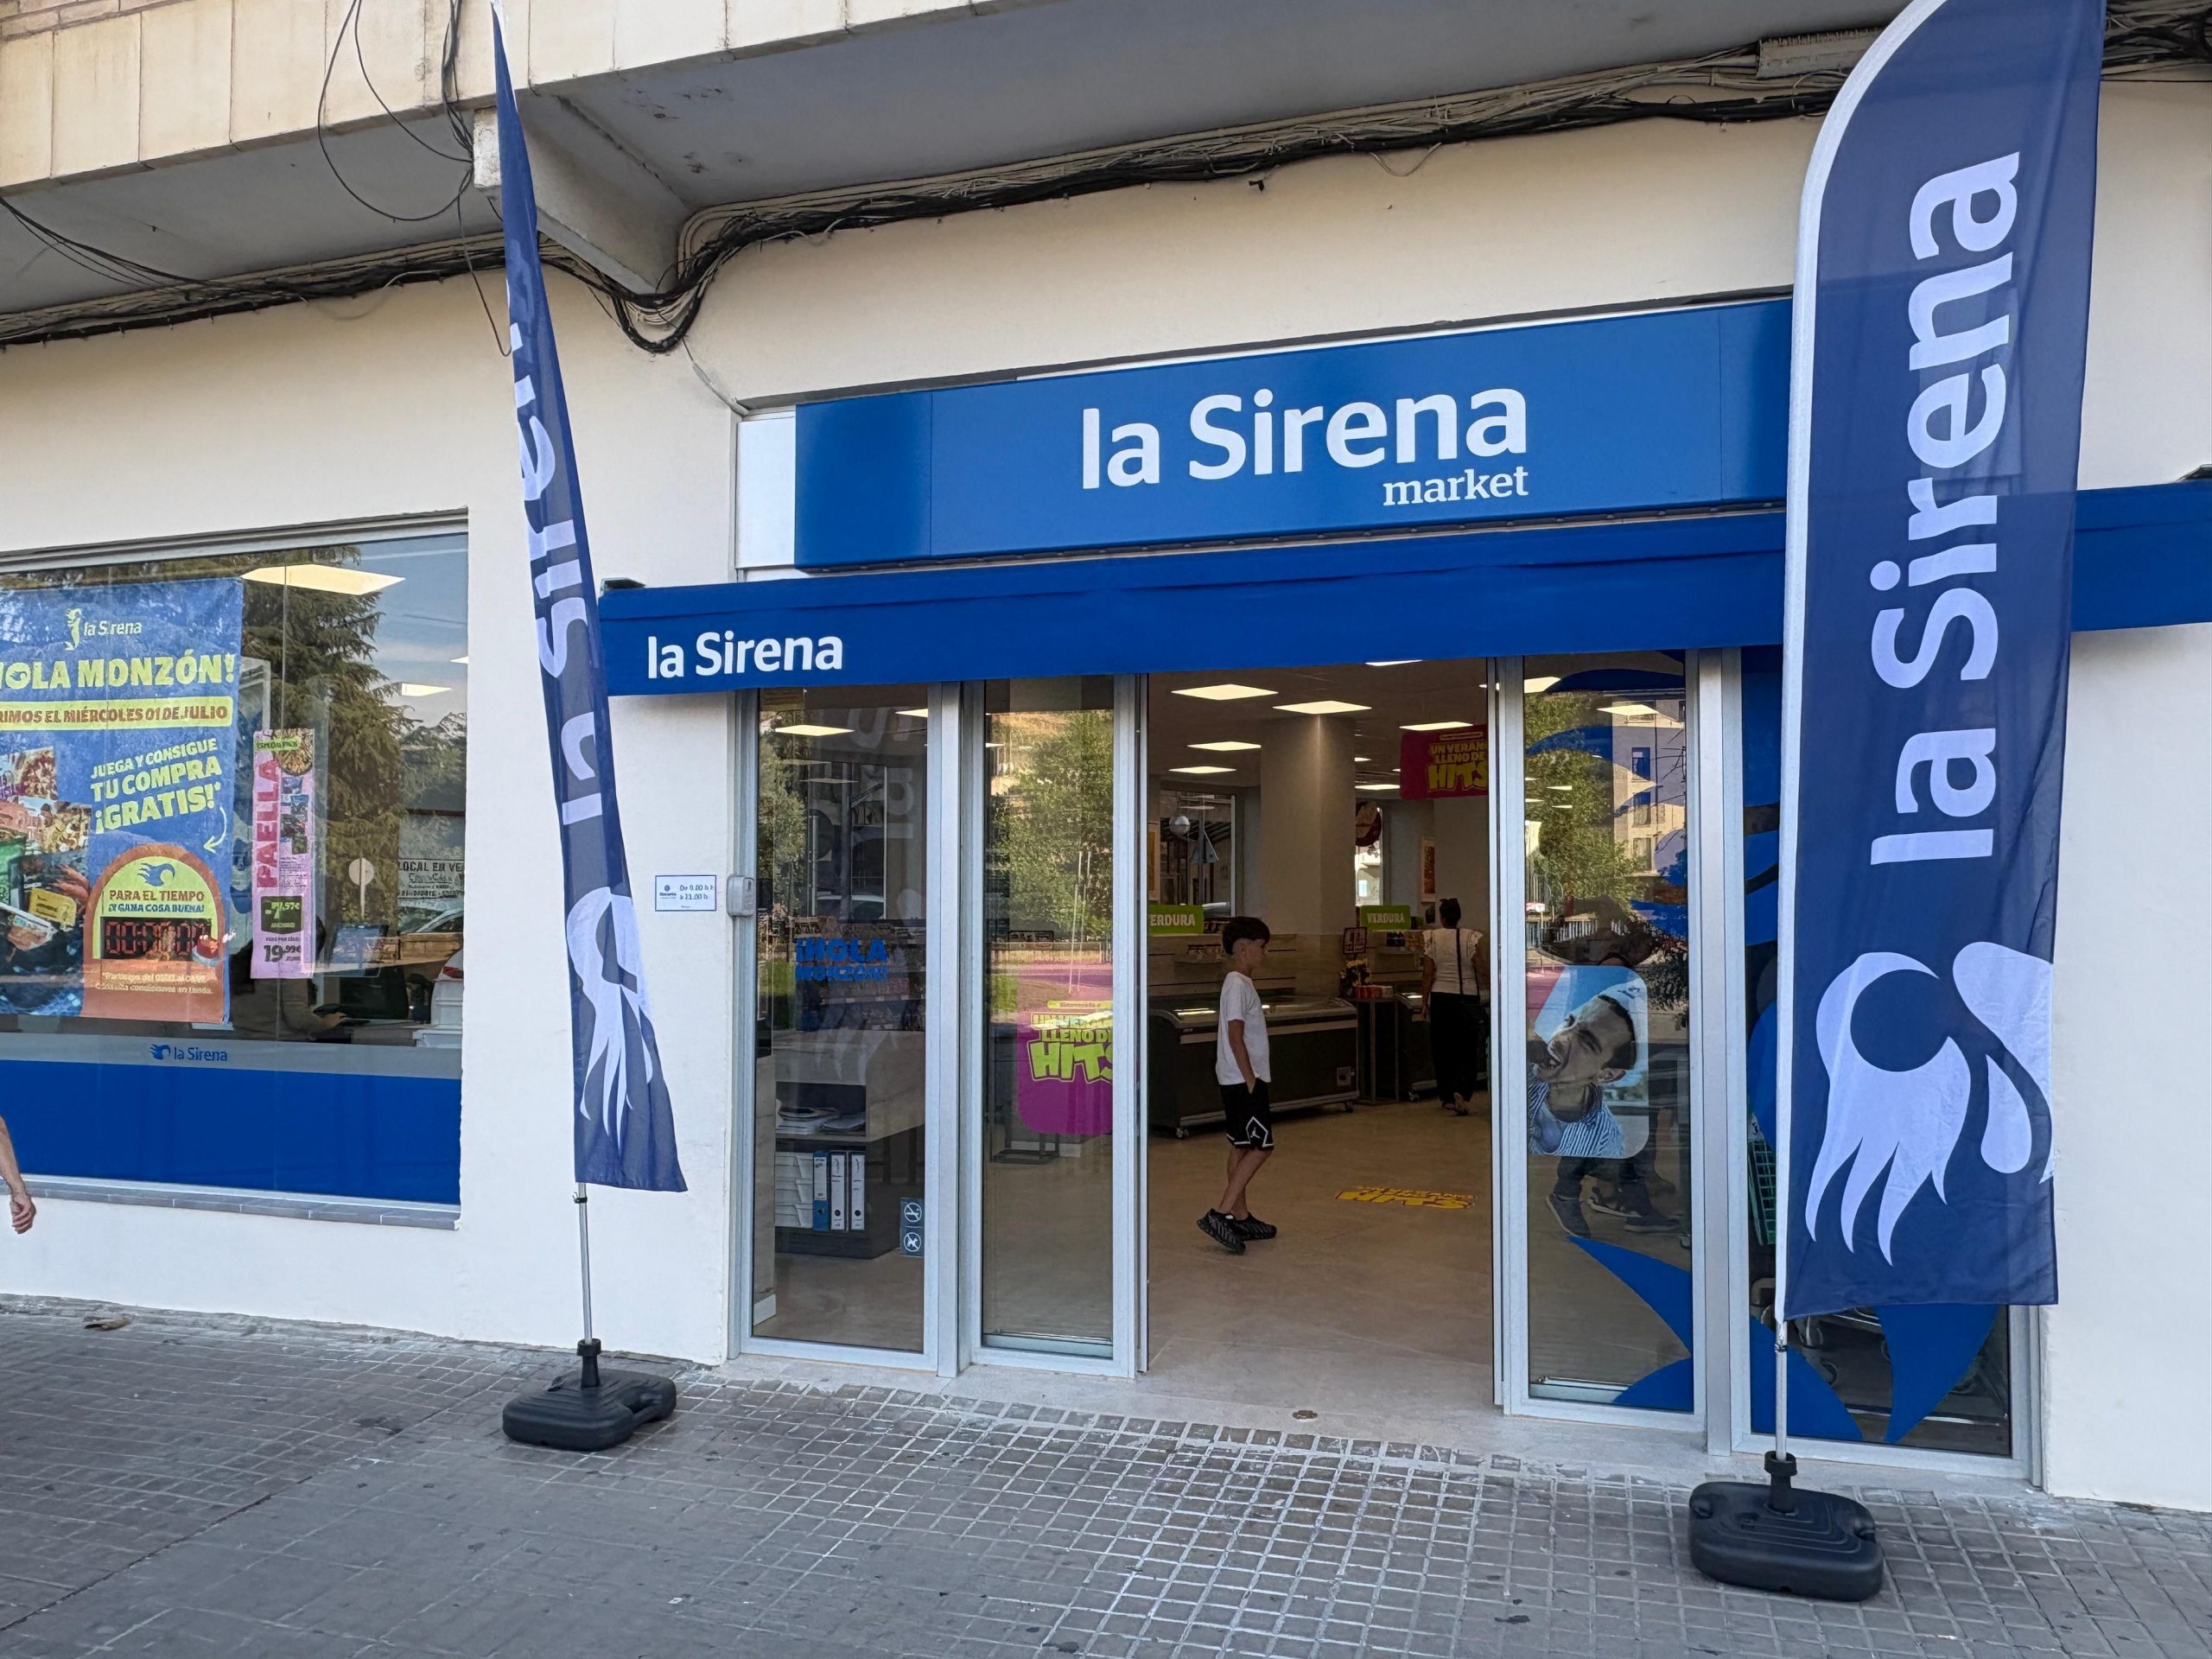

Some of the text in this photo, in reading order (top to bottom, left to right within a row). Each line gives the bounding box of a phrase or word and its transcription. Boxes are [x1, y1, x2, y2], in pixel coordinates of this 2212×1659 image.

[1082, 388, 1527, 489] la Sirena
[1383, 466, 1529, 506] market
[1869, 150, 2020, 865] la Sirena
[84, 621, 96, 636] la
[0, 649, 236, 690] OLA MONZÓN!
[647, 630, 843, 679] la Sirena
[45, 709, 61, 723] EL
[64, 706, 143, 723] MIÉRCOLES
[145, 708, 161, 721] 01
[162, 706, 181, 721] DE
[181, 705, 228, 720] JULIO
[91, 738, 218, 779] JUEGA Y CONSIGUE
[90, 756, 223, 802] TU COMPRA
[256, 760, 281, 888] PAELLA
[109, 890, 205, 901] PARA EL TIEMPO
[145, 904, 170, 913] COSA
[1149, 913, 1196, 926] ERDURA
[174, 1046, 228, 1061] la Sirena
[1041, 1029, 1095, 1042] LLENO
